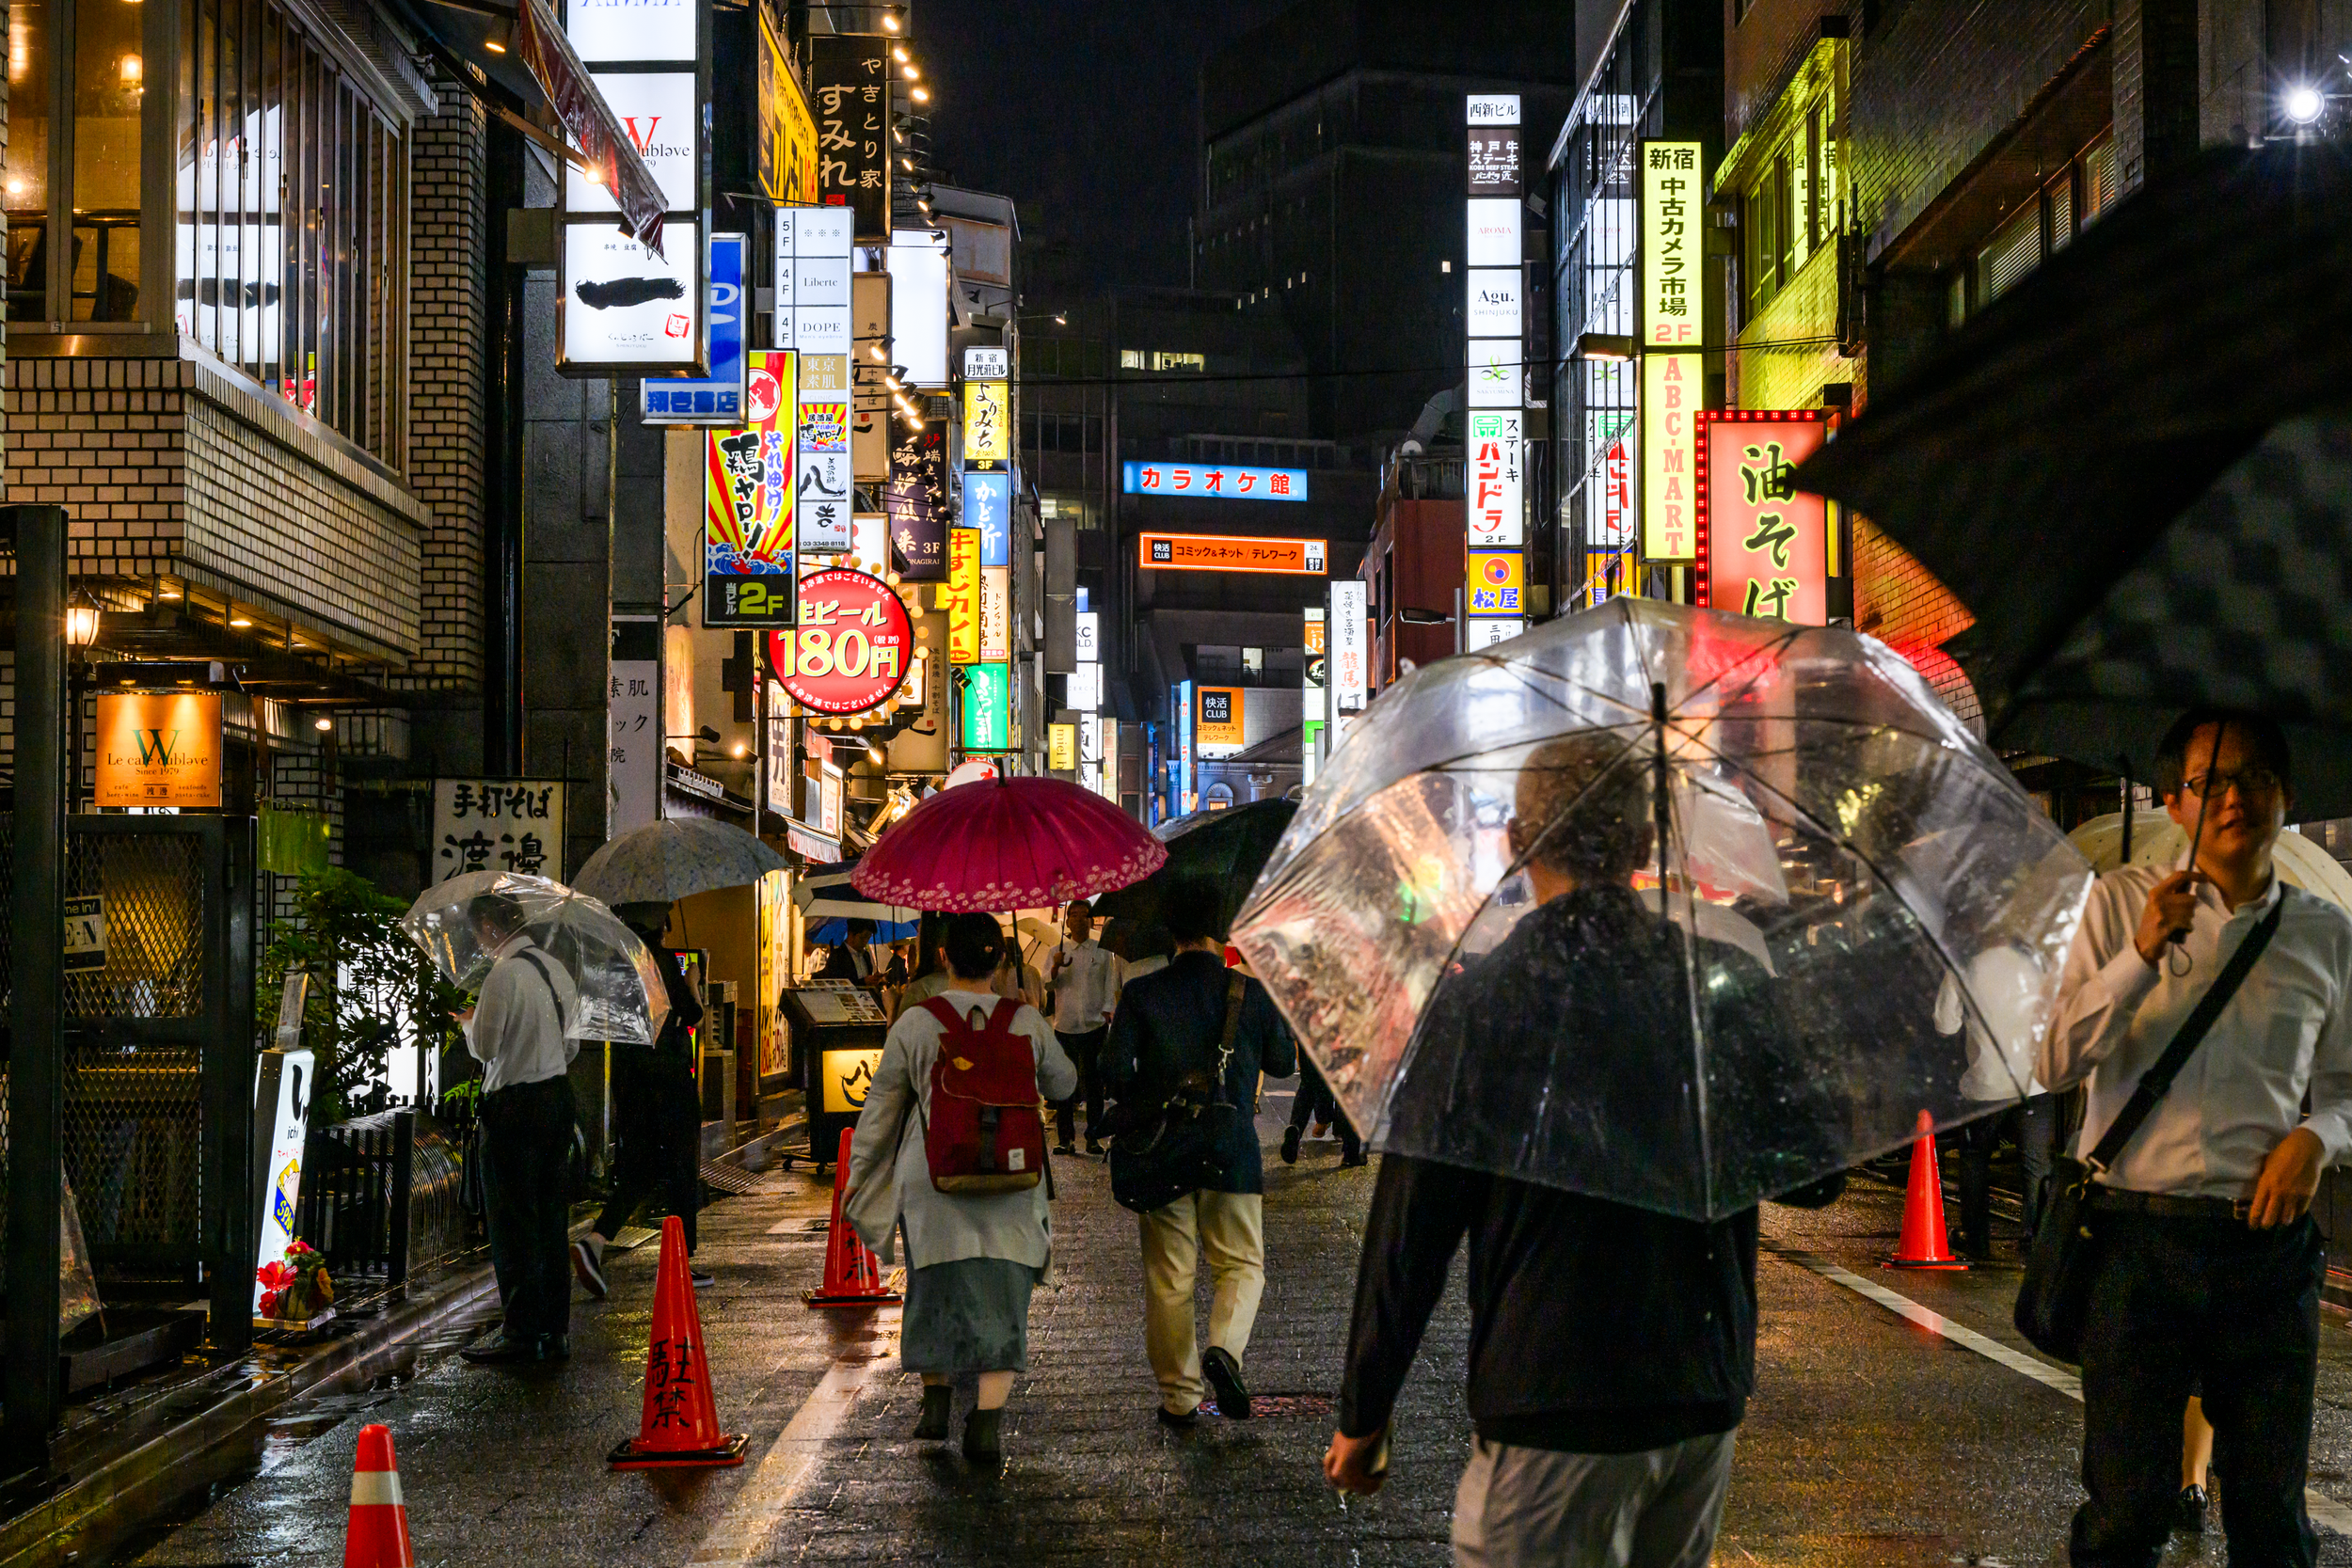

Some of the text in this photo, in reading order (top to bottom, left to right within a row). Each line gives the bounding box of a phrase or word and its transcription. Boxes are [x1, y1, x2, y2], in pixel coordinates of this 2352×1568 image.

[1470, 103, 1518, 118] 西新ビル
[859, 57, 883, 189] やきとり家
[819, 83, 857, 188] すみれ
[1470, 140, 1519, 153] 神戸牛
[1470, 153, 1518, 165] ステーキ
[1649, 148, 1695, 170] 新宿
[1659, 177, 1687, 316] 中古カメラ市場
[1473, 309, 1518, 317] SHINJUKU
[803, 323, 841, 332] DOPE
[1655, 324, 1692, 341] 2F
[805, 356, 836, 372] 東京
[975, 353, 997, 363] 新宿
[805, 373, 836, 388] 素肌
[975, 382, 997, 449] よりみち
[1505, 419, 1519, 483] ステーキ
[977, 460, 993, 470] 3F
[1141, 467, 1291, 496] カラオケ館
[1472, 441, 1503, 533] パンドラ
[923, 542, 941, 554] 3F
[739, 581, 784, 615] 2F
[1471, 587, 1520, 609] 松屋
[1339, 651, 1360, 689] 龍馬
[1205, 697, 1228, 708] 快活
[1205, 709, 1228, 719] CLUB
[131, 728, 183, 768] W
[107, 752, 123, 766] Le
[135, 767, 180, 776] Since 1979
[453, 784, 553, 819] 手打そば
[647, 1336, 697, 1430] 駐禁
